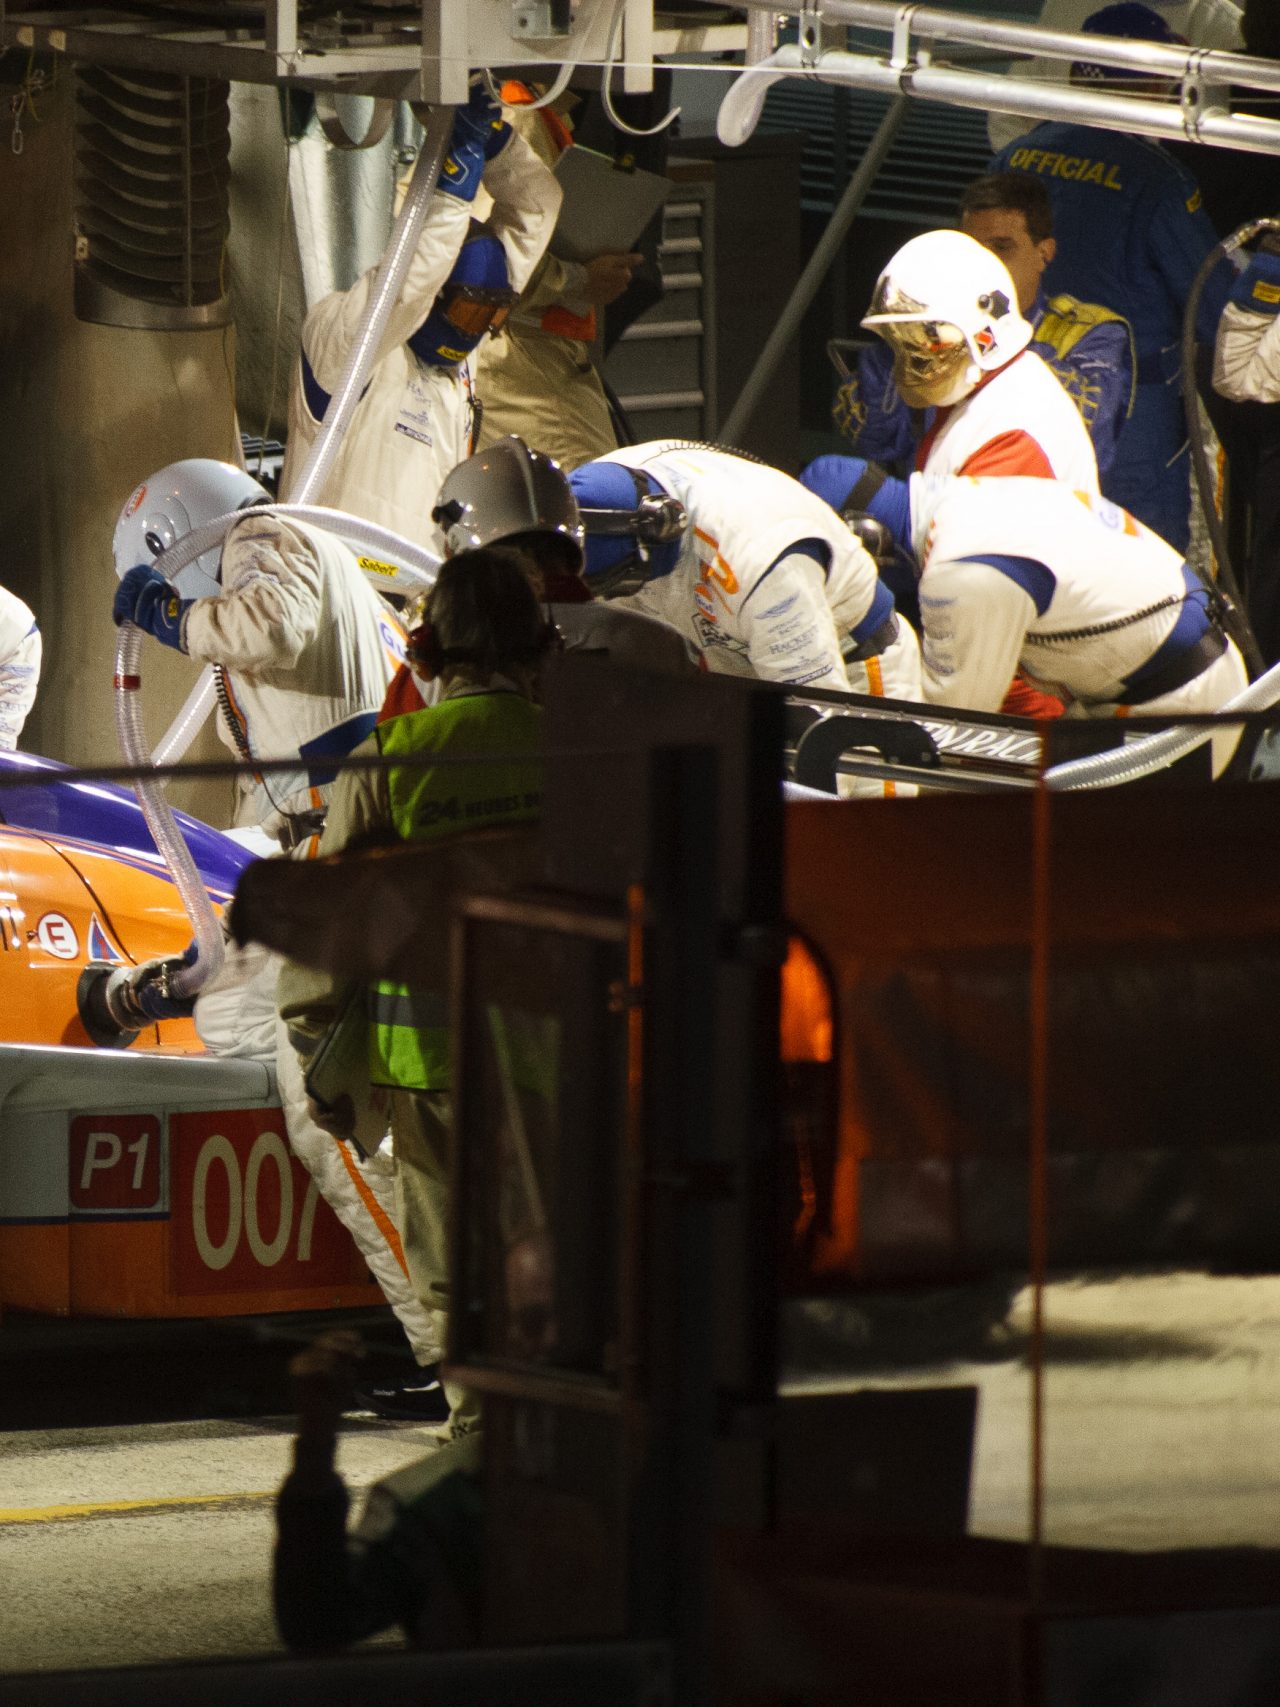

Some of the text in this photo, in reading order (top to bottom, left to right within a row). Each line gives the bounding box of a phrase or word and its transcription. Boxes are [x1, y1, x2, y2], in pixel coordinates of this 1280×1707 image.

[1009, 149, 1122, 191] OFFICIAL
[46, 922, 72, 953] E
[80, 1131, 150, 1190] P1
